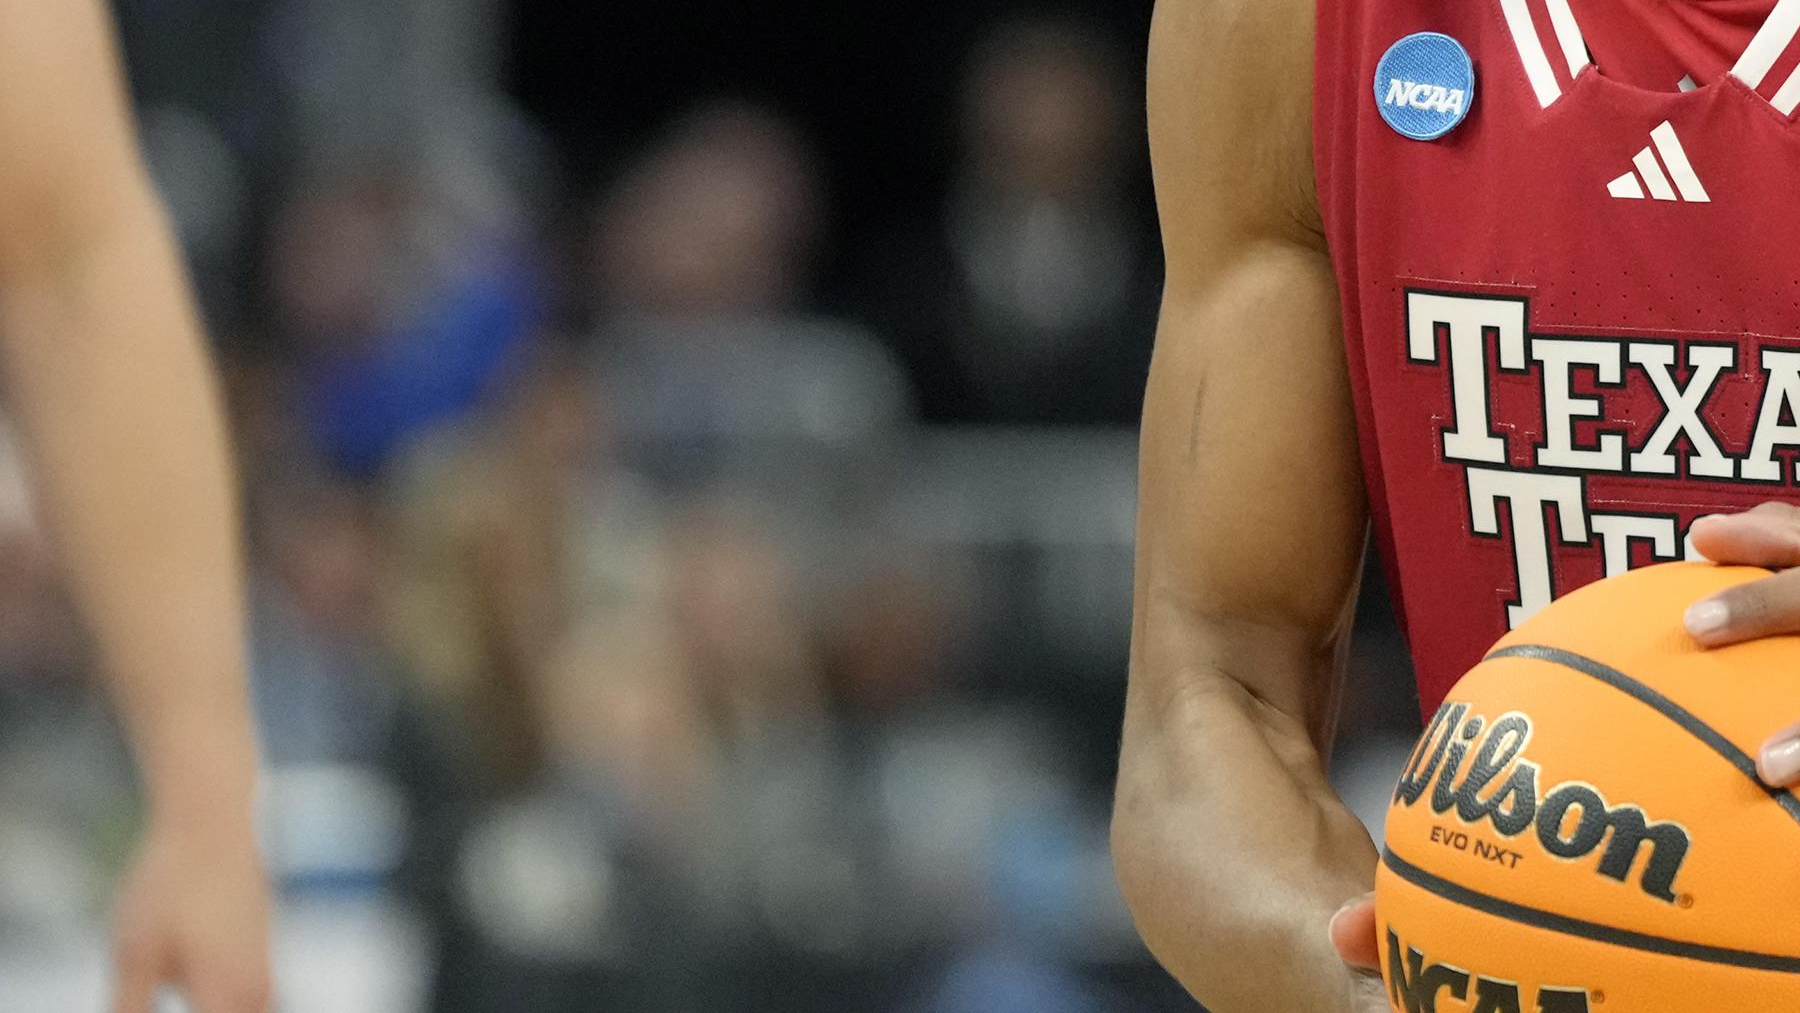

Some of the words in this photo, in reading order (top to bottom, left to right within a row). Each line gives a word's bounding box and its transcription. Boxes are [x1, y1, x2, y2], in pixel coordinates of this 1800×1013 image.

[1385, 78, 1464, 116] NCAA
[1393, 702, 1690, 904] Wilson
[1430, 825, 1468, 850] EVO
[1473, 839, 1524, 870] NXT
